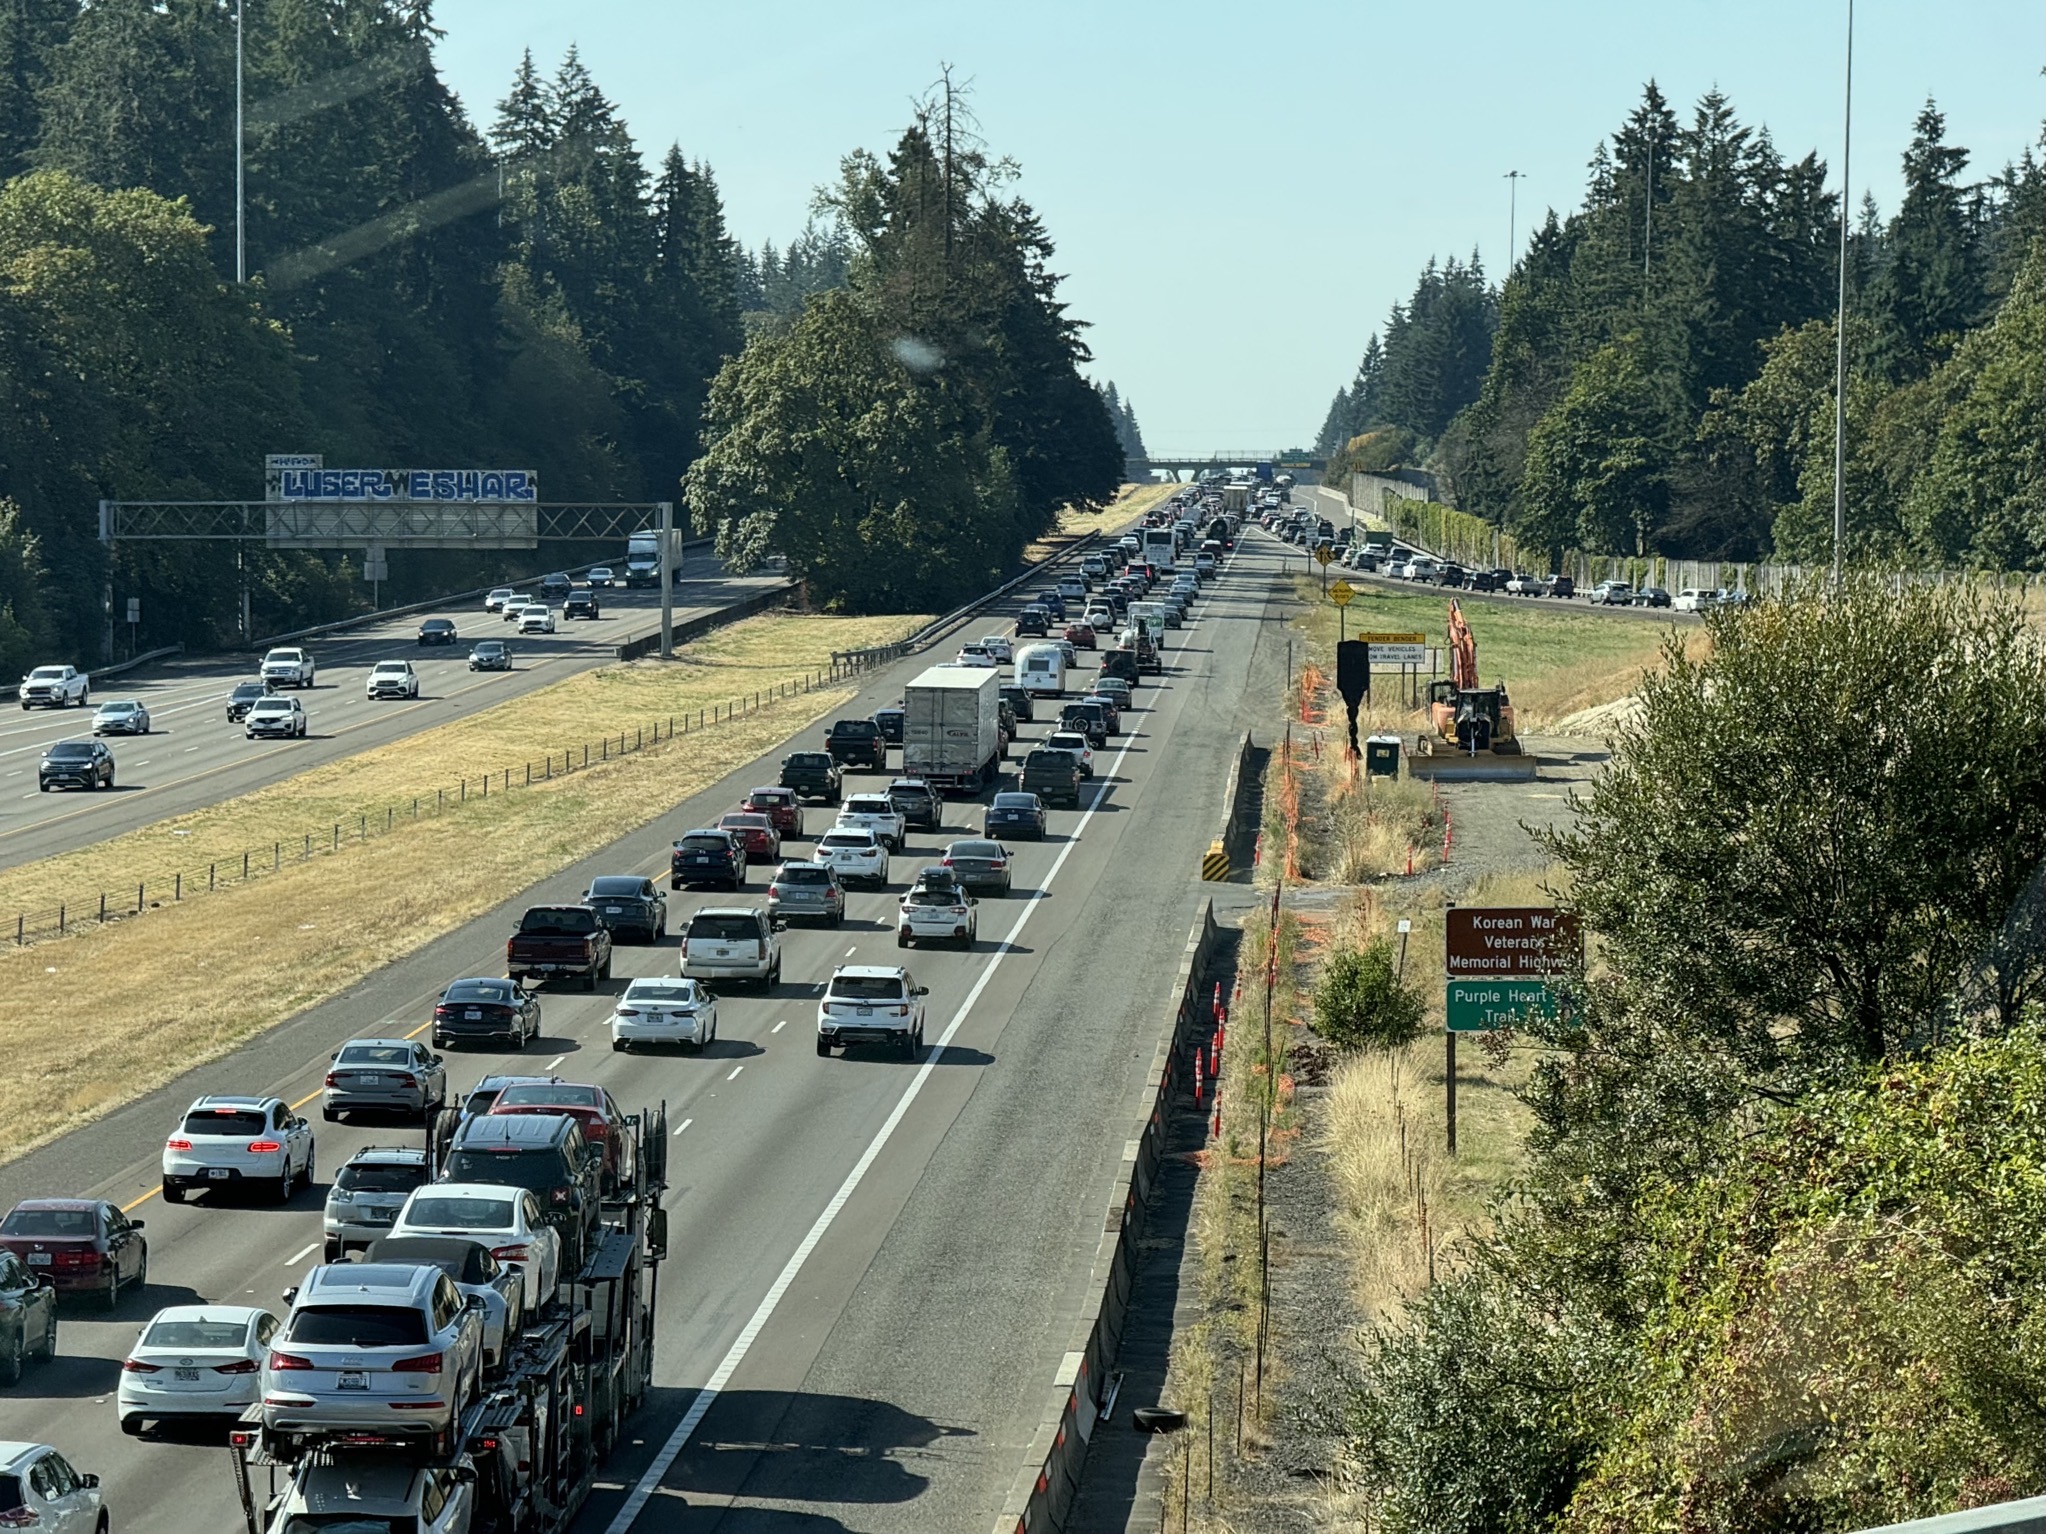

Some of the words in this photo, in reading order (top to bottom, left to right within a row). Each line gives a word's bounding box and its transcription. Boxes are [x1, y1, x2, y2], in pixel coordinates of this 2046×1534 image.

[1473, 915, 1523, 929] Korean
[1530, 915, 1557, 929] War
[1450, 955, 1511, 969] Memorial
[1519, 955, 1564, 972] Highw
[1455, 989, 1501, 1005] Purple
[1508, 989, 1547, 1002] Heart
